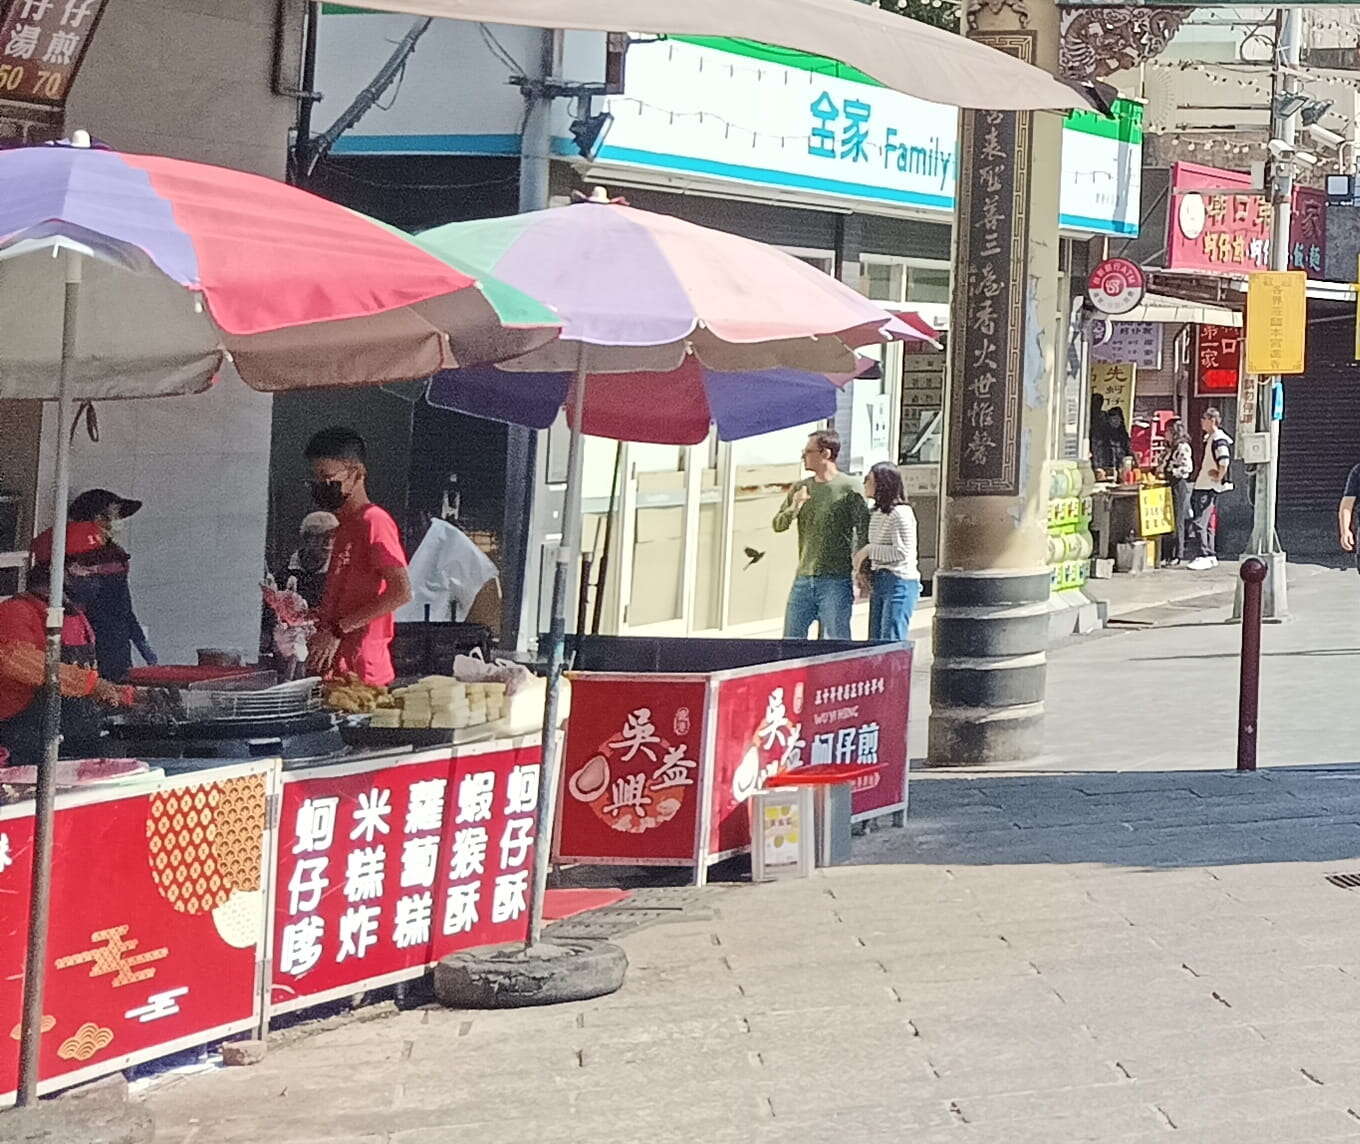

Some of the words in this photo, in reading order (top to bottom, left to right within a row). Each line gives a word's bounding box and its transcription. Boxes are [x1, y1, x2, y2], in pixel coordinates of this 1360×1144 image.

[32, 71, 62, 99] 70
[808, 91, 871, 163] 全家
[885, 128, 952, 191] Family
[336, 788, 392, 963] 米糕炸
[443, 771, 495, 935] 蝦猴酥
[491, 764, 540, 924] 蚵仔酥
